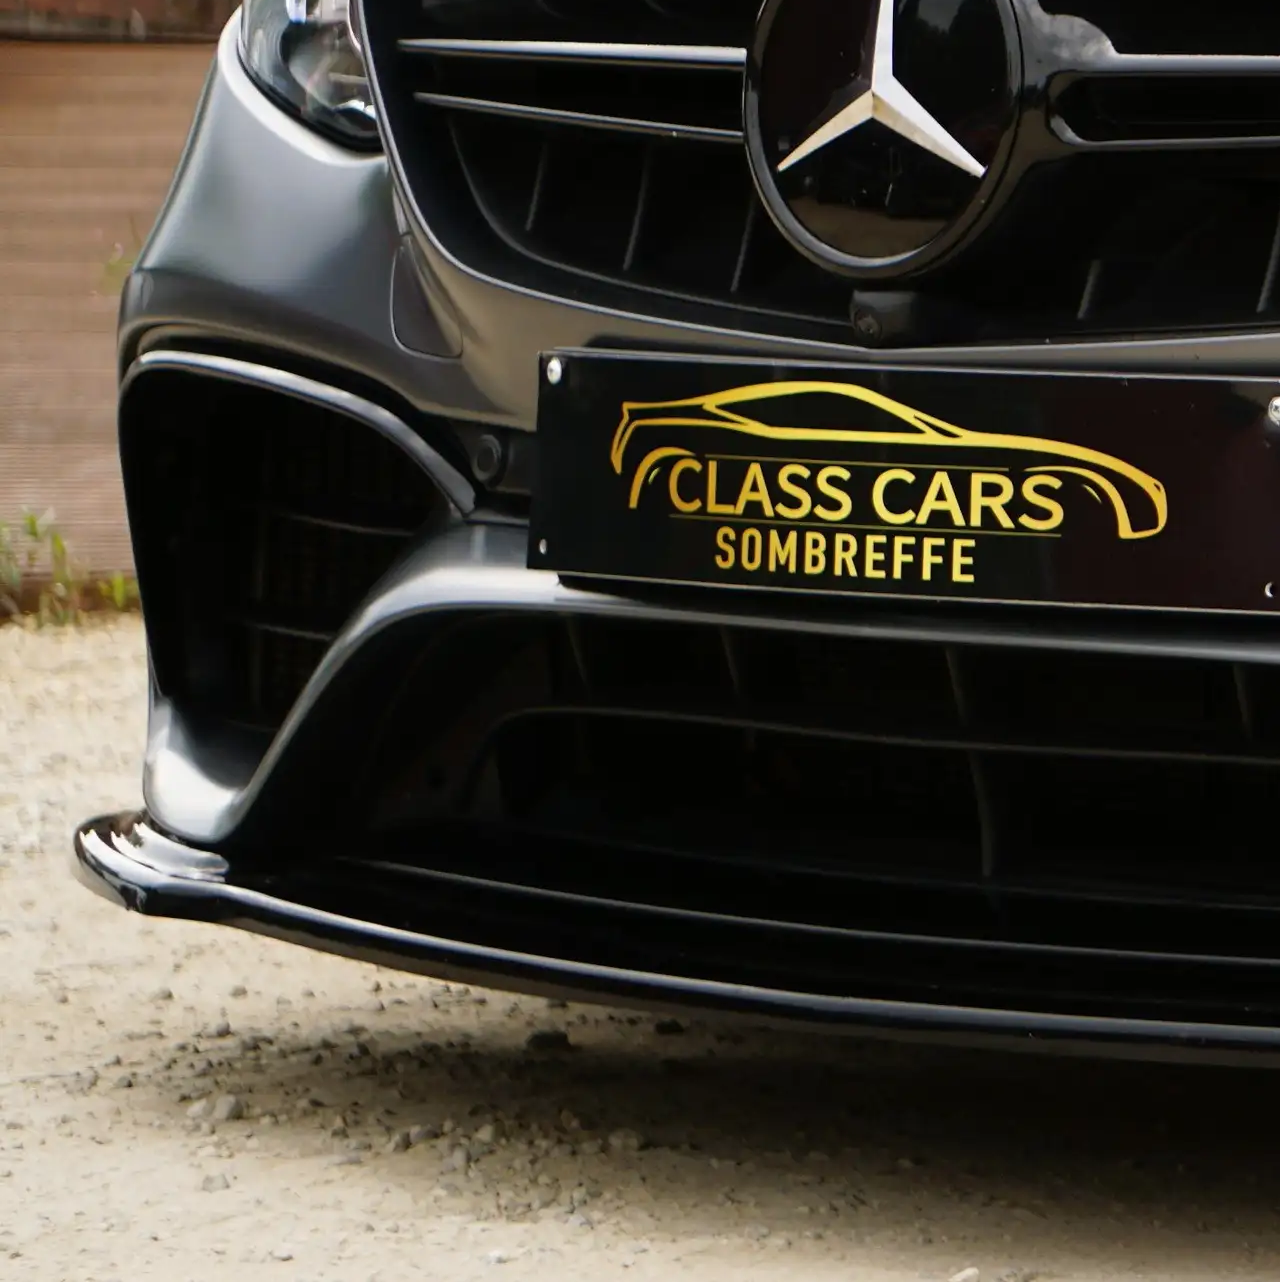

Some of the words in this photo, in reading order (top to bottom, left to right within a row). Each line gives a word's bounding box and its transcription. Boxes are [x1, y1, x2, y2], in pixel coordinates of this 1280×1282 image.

[669, 458, 853, 521] CLASS
[872, 468, 1065, 530] CARS
[714, 525, 976, 583] SOMBREFFE
